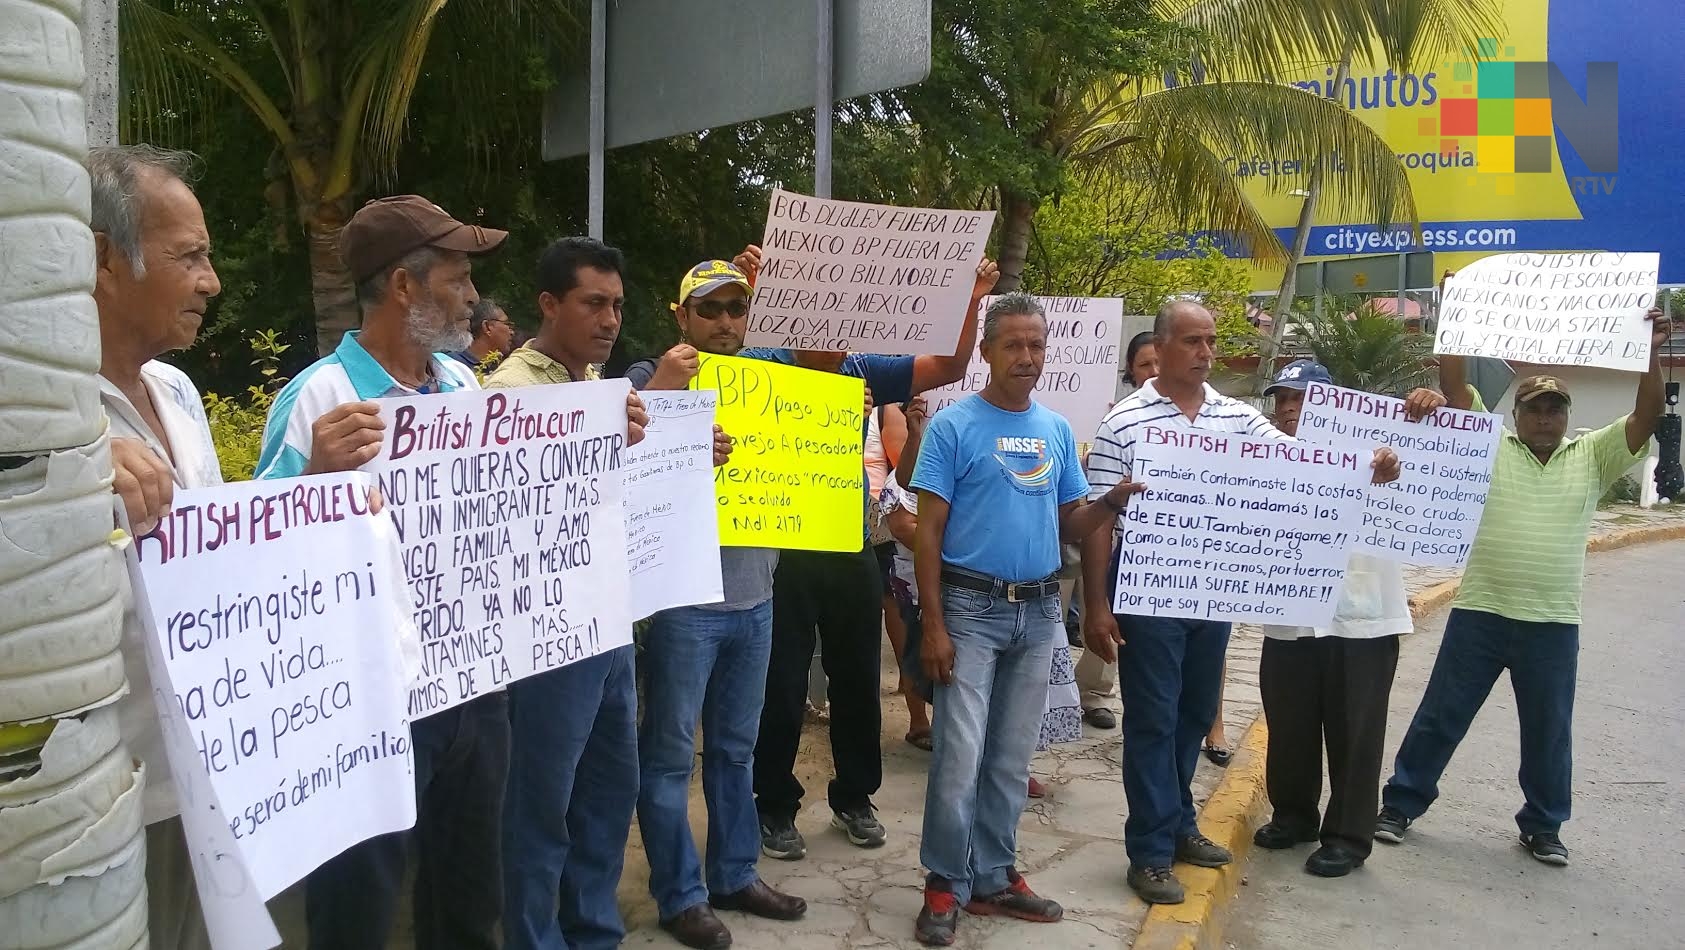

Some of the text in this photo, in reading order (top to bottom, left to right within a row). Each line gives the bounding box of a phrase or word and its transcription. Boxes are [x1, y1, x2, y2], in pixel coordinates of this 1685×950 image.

[886, 211, 948, 233] FUERA
[952, 215, 980, 234] DE
[766, 227, 975, 261] MEXICO BP FUERA DE
[1325, 226, 1516, 252] cityexpress.com
[889, 267, 953, 287] NOBLE
[1550, 271, 1657, 289] PESCADORES
[753, 286, 818, 312] FUERA
[821, 292, 845, 313] DE
[1445, 286, 1551, 310] MEXICANOS
[748, 313, 932, 342] LOZOYA FUERA DE
[1442, 307, 1625, 334] NO SE OLVIDA STATE
[781, 336, 852, 351] MEXICO.
[1438, 345, 1482, 355] MEXICO
[1490, 350, 1534, 362] JUNTO
[1539, 355, 1566, 364] CON
[1440, 329, 1470, 347] OIL
[1493, 334, 1549, 355] TOTAL
[1555, 339, 1614, 358] FUERA
[1622, 341, 1648, 360] DE
[1308, 384, 1493, 433] BRITISH PROLEUM
[1143, 426, 1357, 470] BRITISH PETROLEUM
[379, 468, 408, 505] NO
[416, 463, 441, 502] ME
[452, 448, 530, 497] QUIERAS
[540, 433, 623, 482] CONVERTIR
[1136, 458, 1195, 480] También
[1292, 477, 1314, 495] las
[1420, 462, 1435, 475] el
[1407, 483, 1427, 495] no
[250, 482, 371, 545] PETROLEU
[419, 504, 442, 539] UN
[453, 484, 555, 532] INMIGRANTE
[1128, 504, 1148, 523] de
[1215, 492, 1236, 507] No
[1315, 505, 1339, 520] las
[534, 519, 543, 546] Y
[557, 511, 590, 541] AMO
[1181, 534, 1199, 548] los
[1390, 534, 1405, 551] la
[408, 573, 445, 608] STE
[513, 553, 530, 581] MI
[1120, 572, 1137, 586] MI
[1144, 572, 1198, 590] FAMILIA
[1205, 576, 1250, 594] SUFRE
[167, 562, 375, 660] restringiste mi
[483, 593, 504, 622] YA
[514, 585, 531, 616] NO
[545, 577, 563, 607] LO
[1148, 596, 1172, 615] que
[1178, 597, 1199, 614] soy
[213, 657, 251, 707] de
[458, 667, 478, 699] DE
[491, 656, 512, 685] LA
[271, 681, 353, 758] pesca
[245, 778, 286, 834] será
